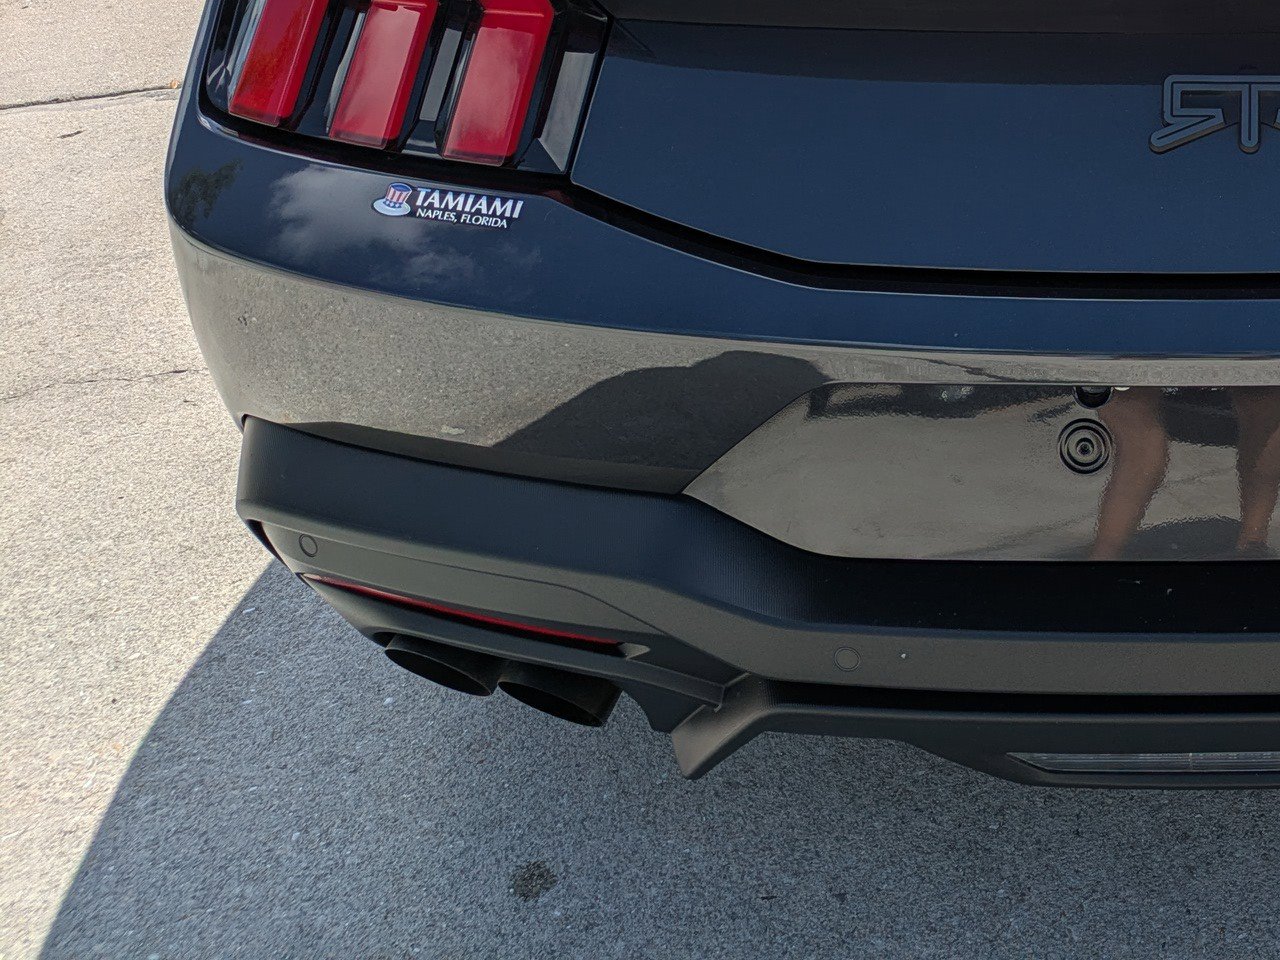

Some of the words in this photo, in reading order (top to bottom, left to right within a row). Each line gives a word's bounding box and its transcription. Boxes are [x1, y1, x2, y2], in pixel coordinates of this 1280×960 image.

[415, 187, 524, 219] TAMIAMI
[416, 208, 458, 223] NAPLES,
[460, 214, 508, 229] FLORIDA
